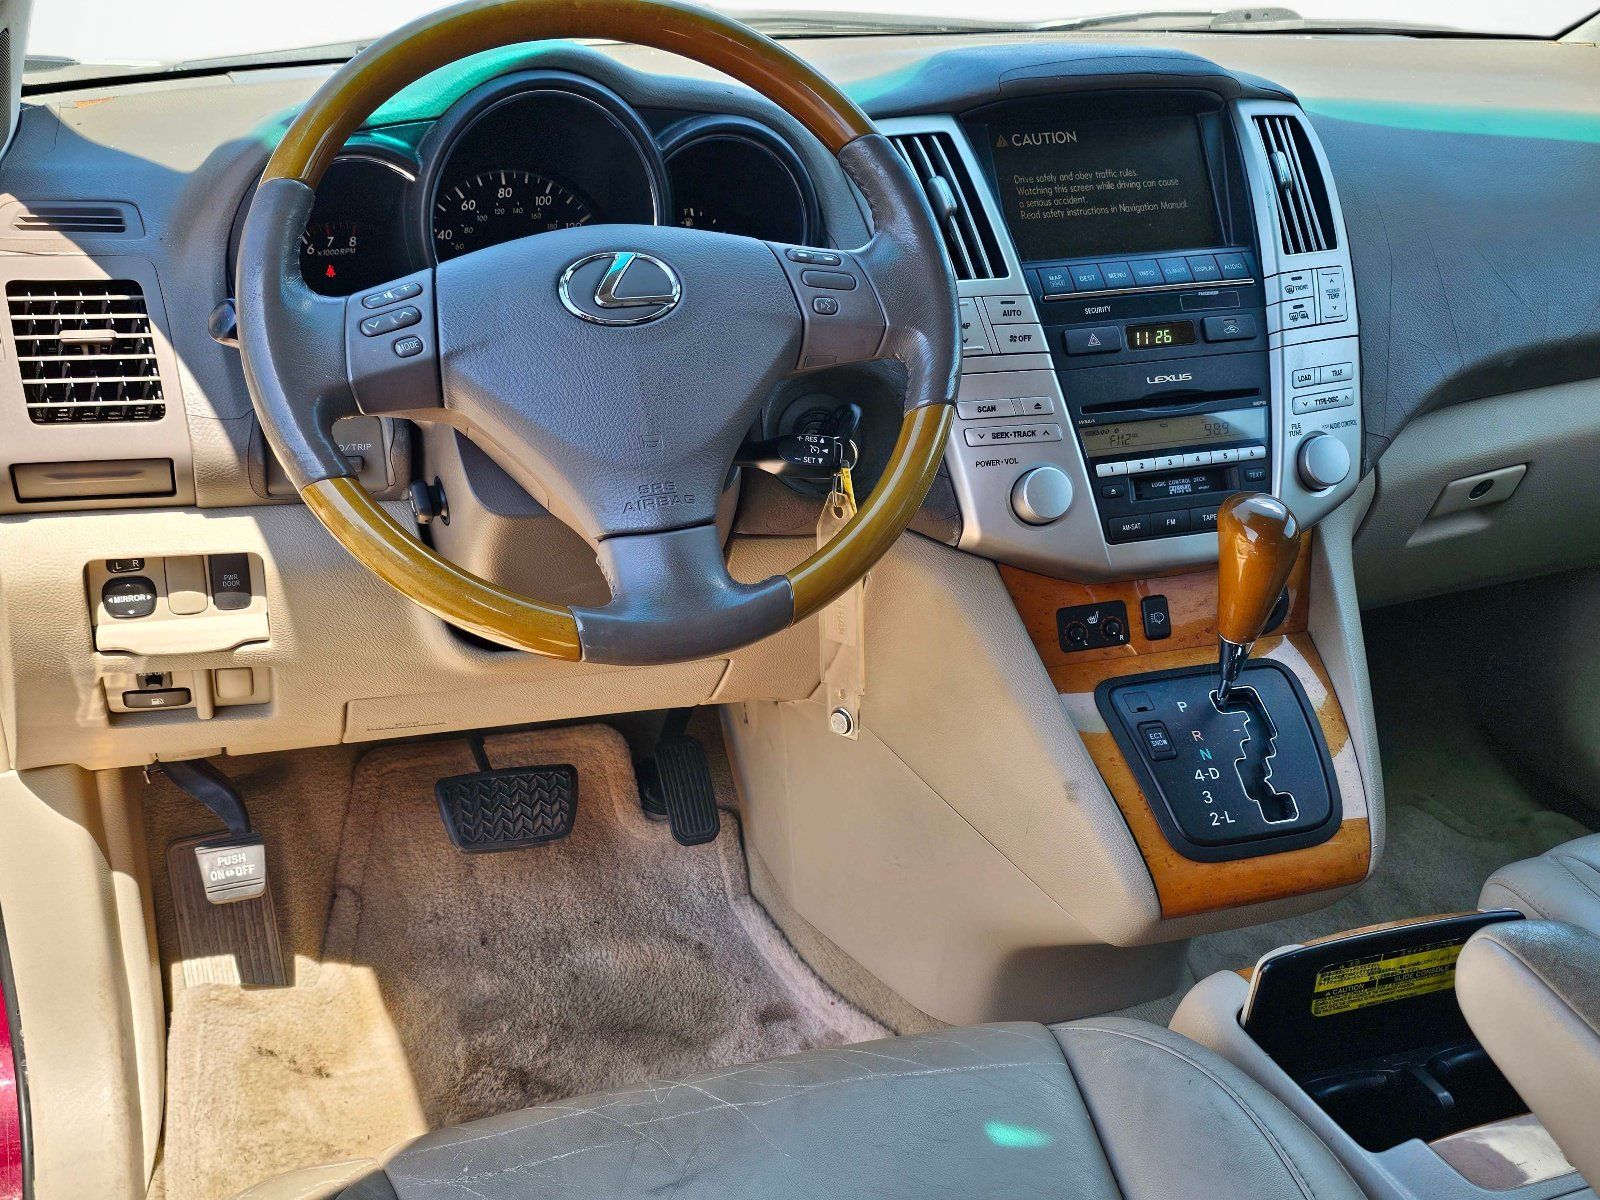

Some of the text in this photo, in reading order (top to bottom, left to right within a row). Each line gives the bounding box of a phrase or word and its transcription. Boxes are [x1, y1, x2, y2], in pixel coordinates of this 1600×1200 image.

[1011, 131, 1077, 147] CAUTION
[1013, 174, 1034, 184] Drive
[1035, 172, 1057, 184] safely
[1059, 171, 1074, 182] and
[1075, 170, 1093, 181] obey
[1095, 168, 1118, 179] traffic
[497, 187, 513, 198] 80
[1016, 178, 1180, 197] Watching this screen while driving can cause
[461, 200, 476, 211] 60
[535, 196, 552, 206] 100
[1026, 198, 1052, 208] serious
[1020, 210, 1041, 220] Read
[1042, 208, 1065, 219] safety
[1066, 205, 1110, 217] instructions
[1110, 205, 1118, 214] in
[1119, 202, 1159, 214] Navigation
[437, 229, 453, 241] 40
[327, 236, 335, 248] 7
[349, 236, 357, 247] 8
[307, 243, 315, 255] 6
[455, 243, 465, 251] 60
[1194, 265, 1215, 273] DISPLAY
[1224, 263, 1243, 271] AUDIO
[1079, 274, 1096, 282] DEST
[1139, 269, 1155, 277] INFO
[1002, 309, 1022, 318] AUTO
[1084, 305, 1112, 315] SECURITY
[1018, 334, 1033, 343] OFF
[397, 339, 420, 352] MODE
[1146, 372, 1193, 384] LEXUS
[1297, 374, 1312, 383] LOAD
[977, 404, 997, 413] SCAN
[804, 435, 818, 443] RES
[1288, 430, 1303, 438] TUNE
[803, 456, 816, 464] SET
[1249, 471, 1263, 479] TEXT
[1151, 480, 1167, 488] LOGIC
[1168, 478, 1191, 486] CONTROL
[622, 494, 696, 514] AIRBAG
[1166, 518, 1176, 526] FM
[1202, 513, 1217, 521] TAPE
[115, 559, 139, 570] L R
[223, 573, 239, 581] PWR
[222, 580, 241, 588] DOOR
[113, 593, 147, 603] MIRROR
[1177, 701, 1188, 713] P
[1149, 732, 1163, 740] ECT
[1191, 730, 1204, 742] R
[1151, 739, 1168, 747] SNOW
[1199, 748, 1213, 761] N
[1194, 767, 1220, 782] 4-D
[1202, 790, 1213, 804] 3
[1209, 810, 1236, 827] 2-L
[217, 852, 247, 867] PUSH
[1332, 983, 1365, 996] CAUTION
[1394, 973, 1415, 983] SLIDE
[1415, 965, 1450, 978] CONSOLE
